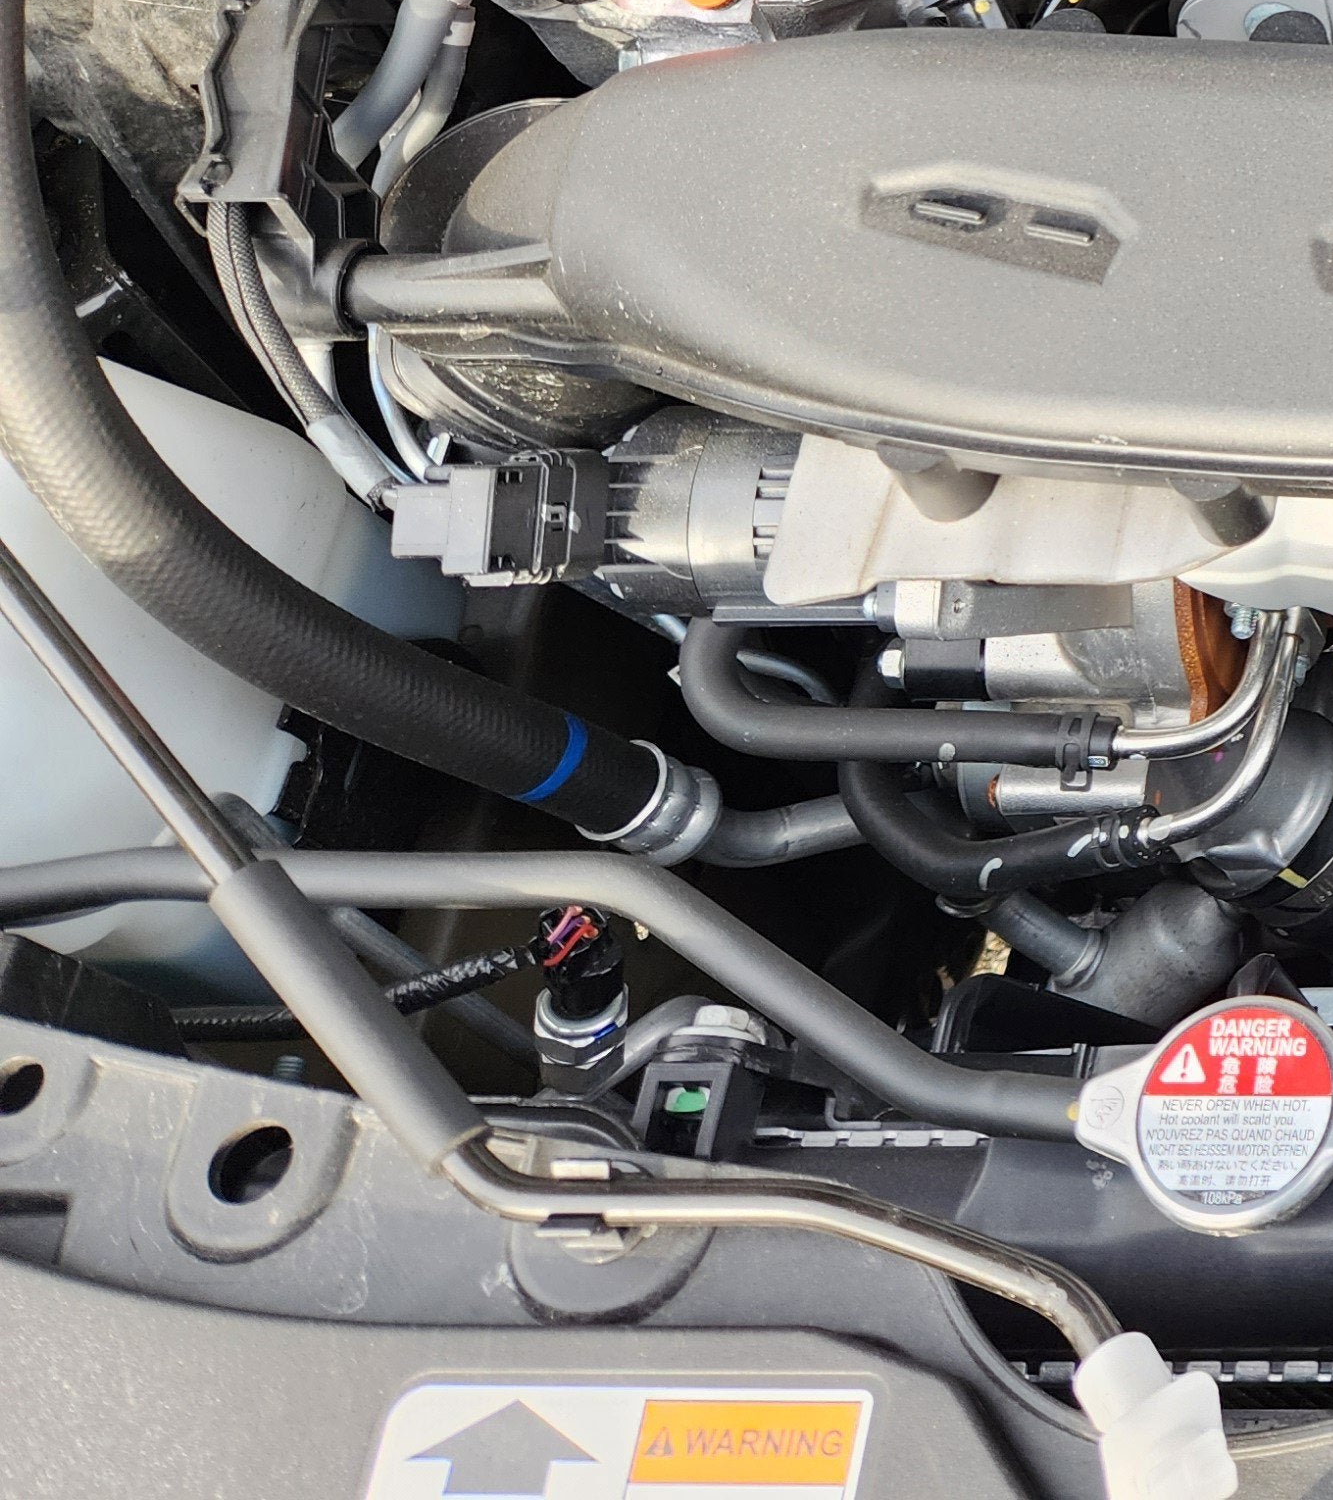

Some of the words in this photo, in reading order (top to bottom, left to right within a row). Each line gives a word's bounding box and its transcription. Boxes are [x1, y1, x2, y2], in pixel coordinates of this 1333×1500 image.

[1210, 1018, 1292, 1038] DANGER
[1208, 1036, 1307, 1057] WARNUNG
[1162, 1099, 1203, 1112] NEVER
[1206, 1099, 1239, 1112] OPEN
[1243, 1099, 1280, 1112] WHEN
[1282, 1099, 1312, 1112] HOT.
[1159, 1114, 1179, 1126] Hot
[1180, 1114, 1220, 1126] coolant
[1223, 1114, 1239, 1126] will
[1242, 1114, 1272, 1126] scald
[1146, 1128, 1203, 1141] N'OUVREZ
[1205, 1128, 1228, 1141] PAS
[1231, 1128, 1272, 1142] QUAND
[1148, 1144, 1177, 1157] NICHT
[1177, 1144, 1195, 1157] BEI
[1195, 1144, 1235, 1157] HEISSEM
[1237, 1144, 1270, 1157] MOTOR
[1201, 1191, 1243, 1205] 108kPa
[685, 1427, 844, 1459] WARNING
